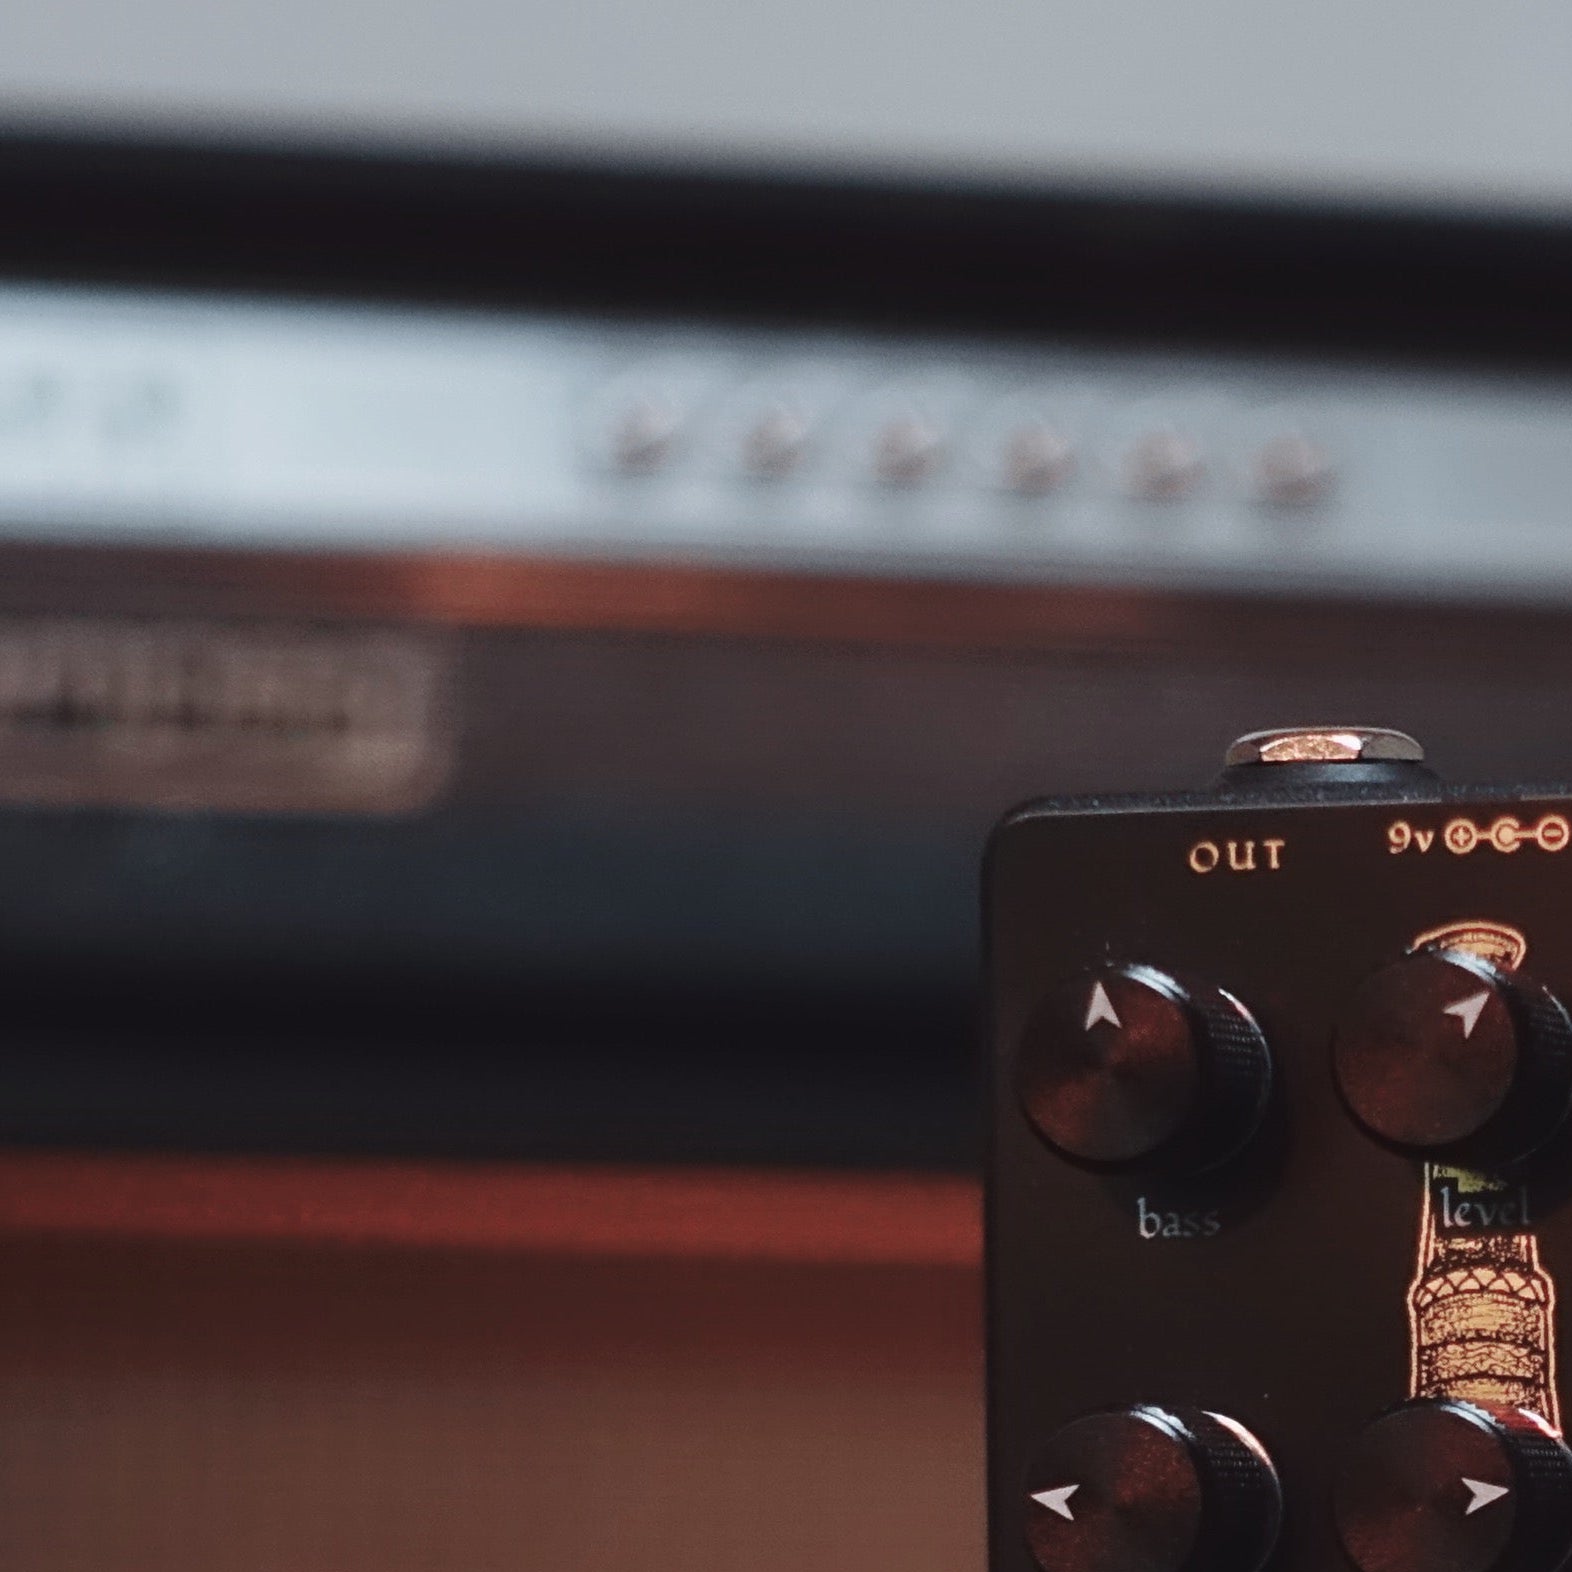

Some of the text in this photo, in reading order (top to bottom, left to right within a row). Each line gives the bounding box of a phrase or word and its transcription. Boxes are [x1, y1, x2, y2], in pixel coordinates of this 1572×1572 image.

[1189, 839, 1286, 874] OUT
[1136, 1196, 1221, 1240] bass
[1440, 1185, 1531, 1229] level
